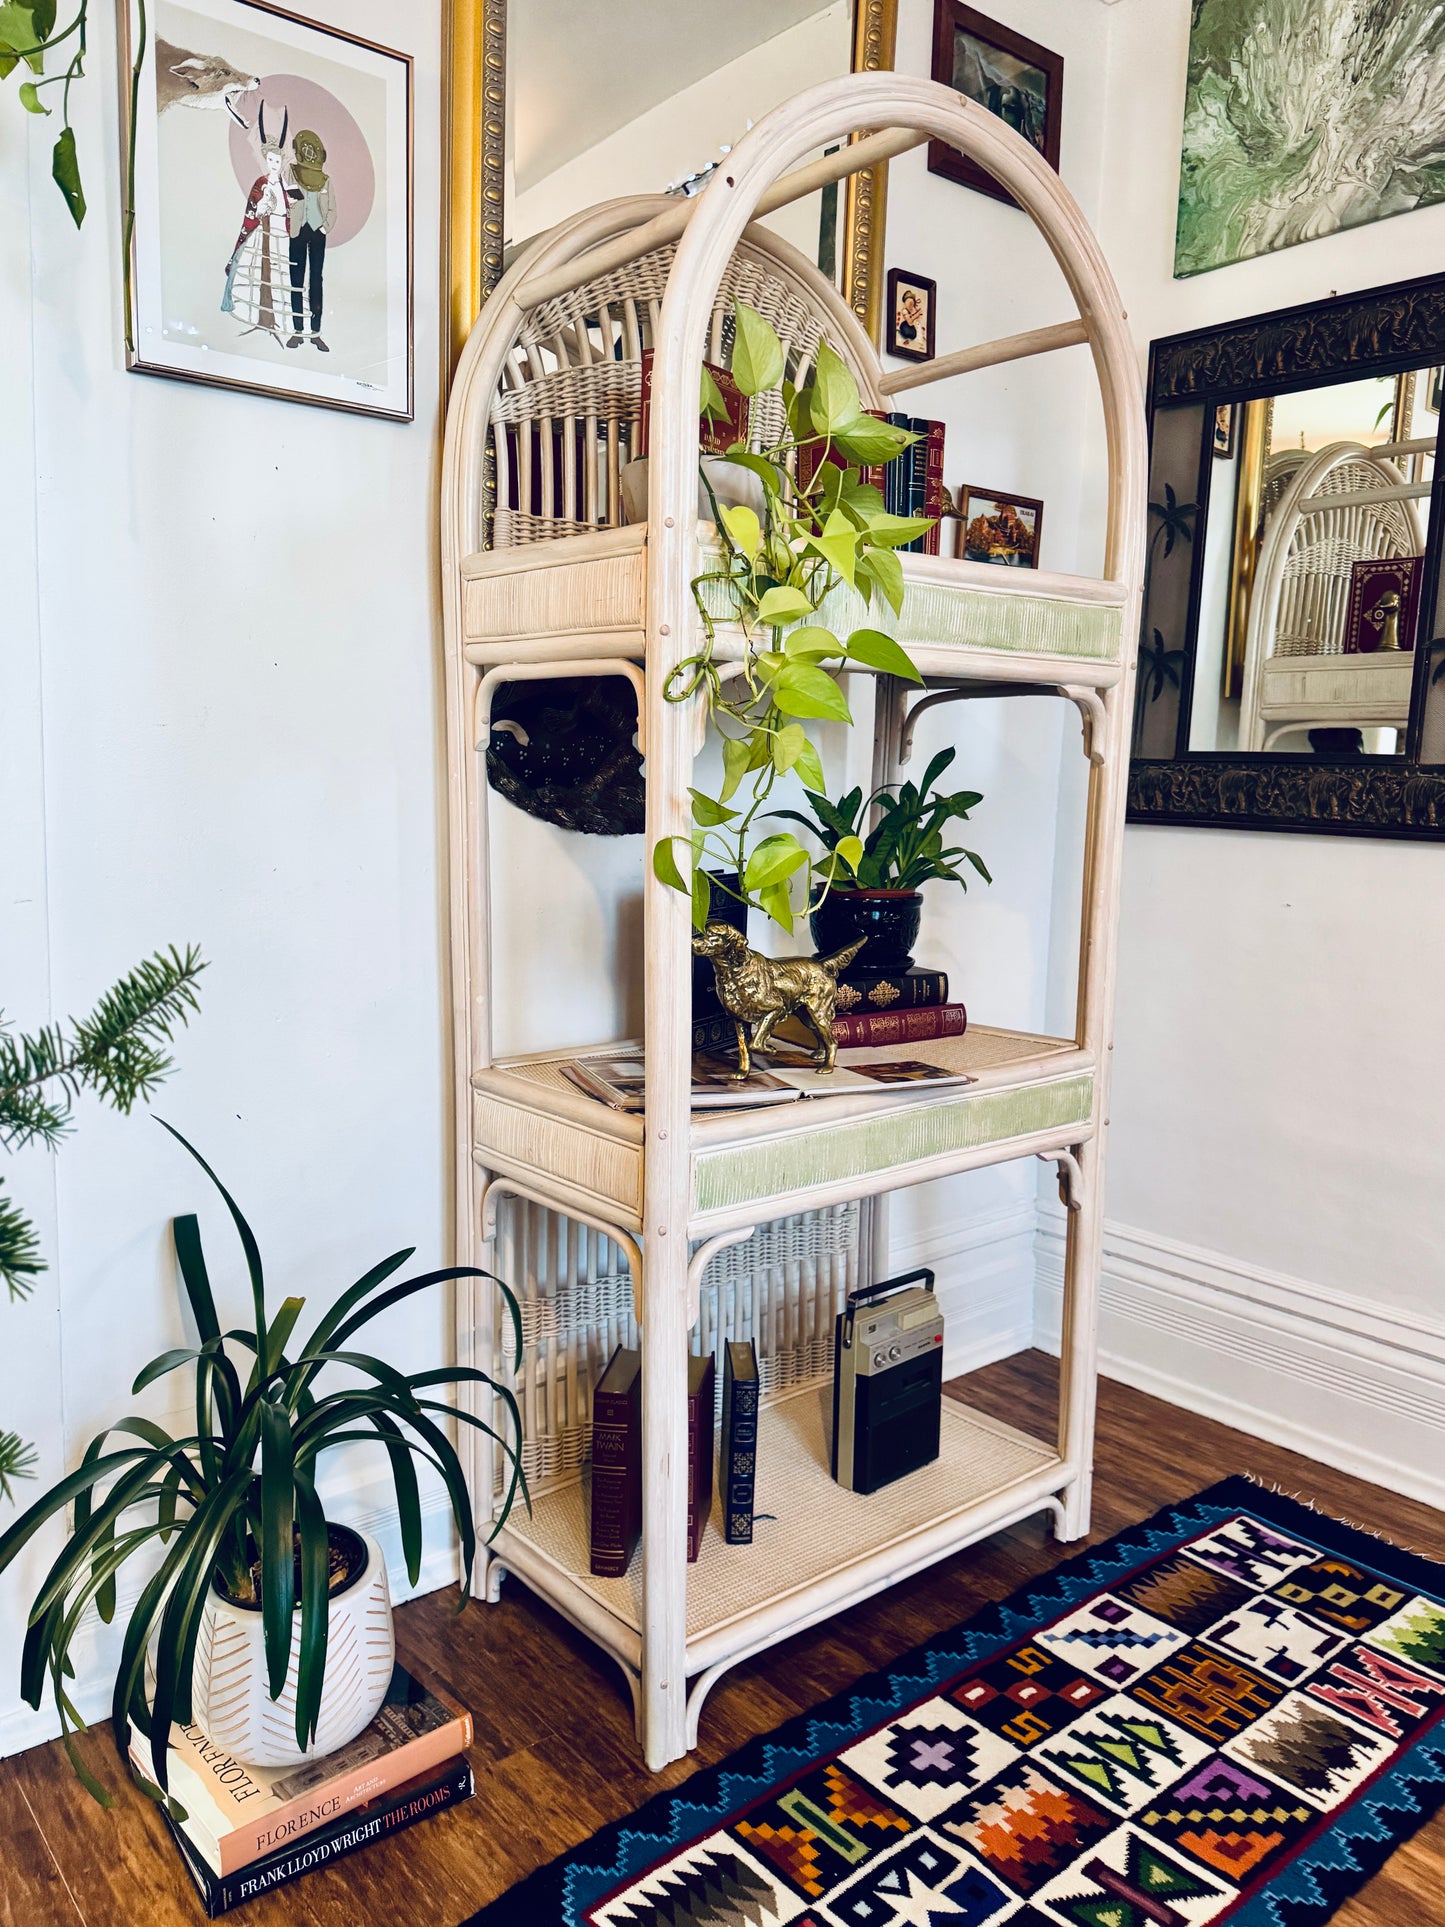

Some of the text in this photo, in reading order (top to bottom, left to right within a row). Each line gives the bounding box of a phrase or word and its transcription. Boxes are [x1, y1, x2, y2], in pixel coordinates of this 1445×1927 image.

[596, 1440, 624, 1451] TWAIN
[599, 1433, 621, 1441] MARK
[345, 1779, 386, 1804] ARCHITECTURE
[354, 1777, 378, 1793] ART AND
[255, 1797, 342, 1851] FLORENCE
[239, 1785, 452, 1898] FRANK LLOYD WRIGHT THE ROOMS
